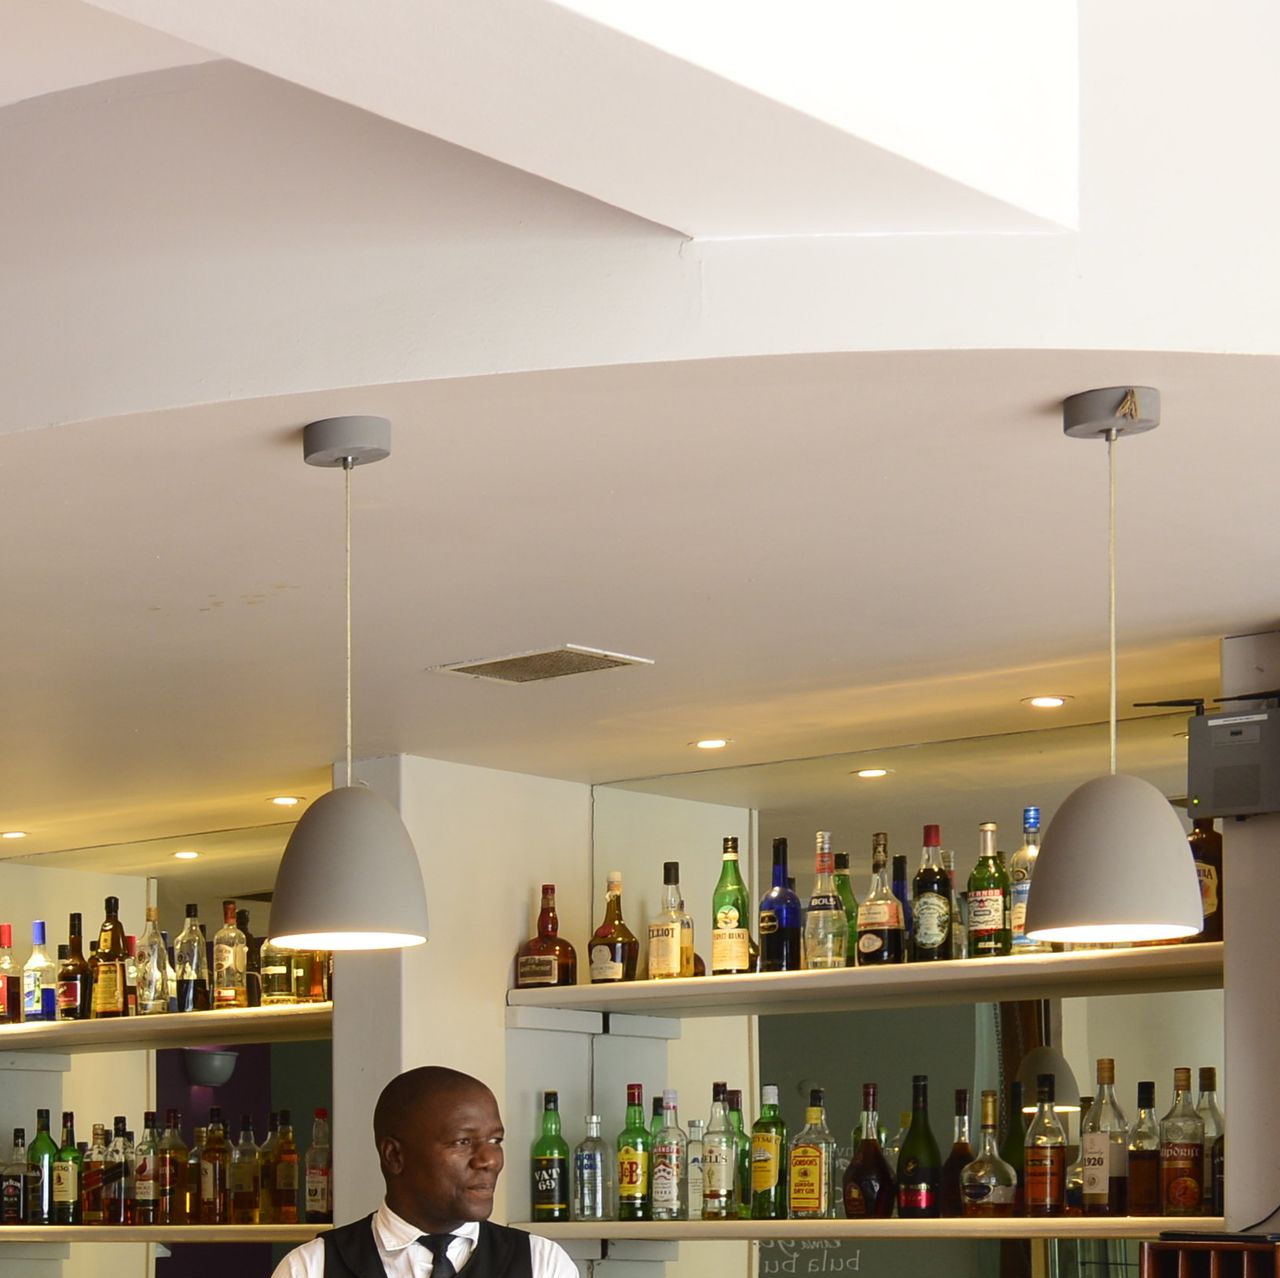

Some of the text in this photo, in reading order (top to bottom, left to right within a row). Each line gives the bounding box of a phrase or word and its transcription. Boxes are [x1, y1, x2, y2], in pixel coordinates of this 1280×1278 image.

[968, 889, 1001, 897] PERNOD
[811, 898, 836, 906] BOLS
[791, 1159, 817, 1168] GORDON'S
[1083, 1156, 1104, 1167] 1920
[534, 1167, 561, 1181] VAT
[538, 1180, 556, 1191] 69
